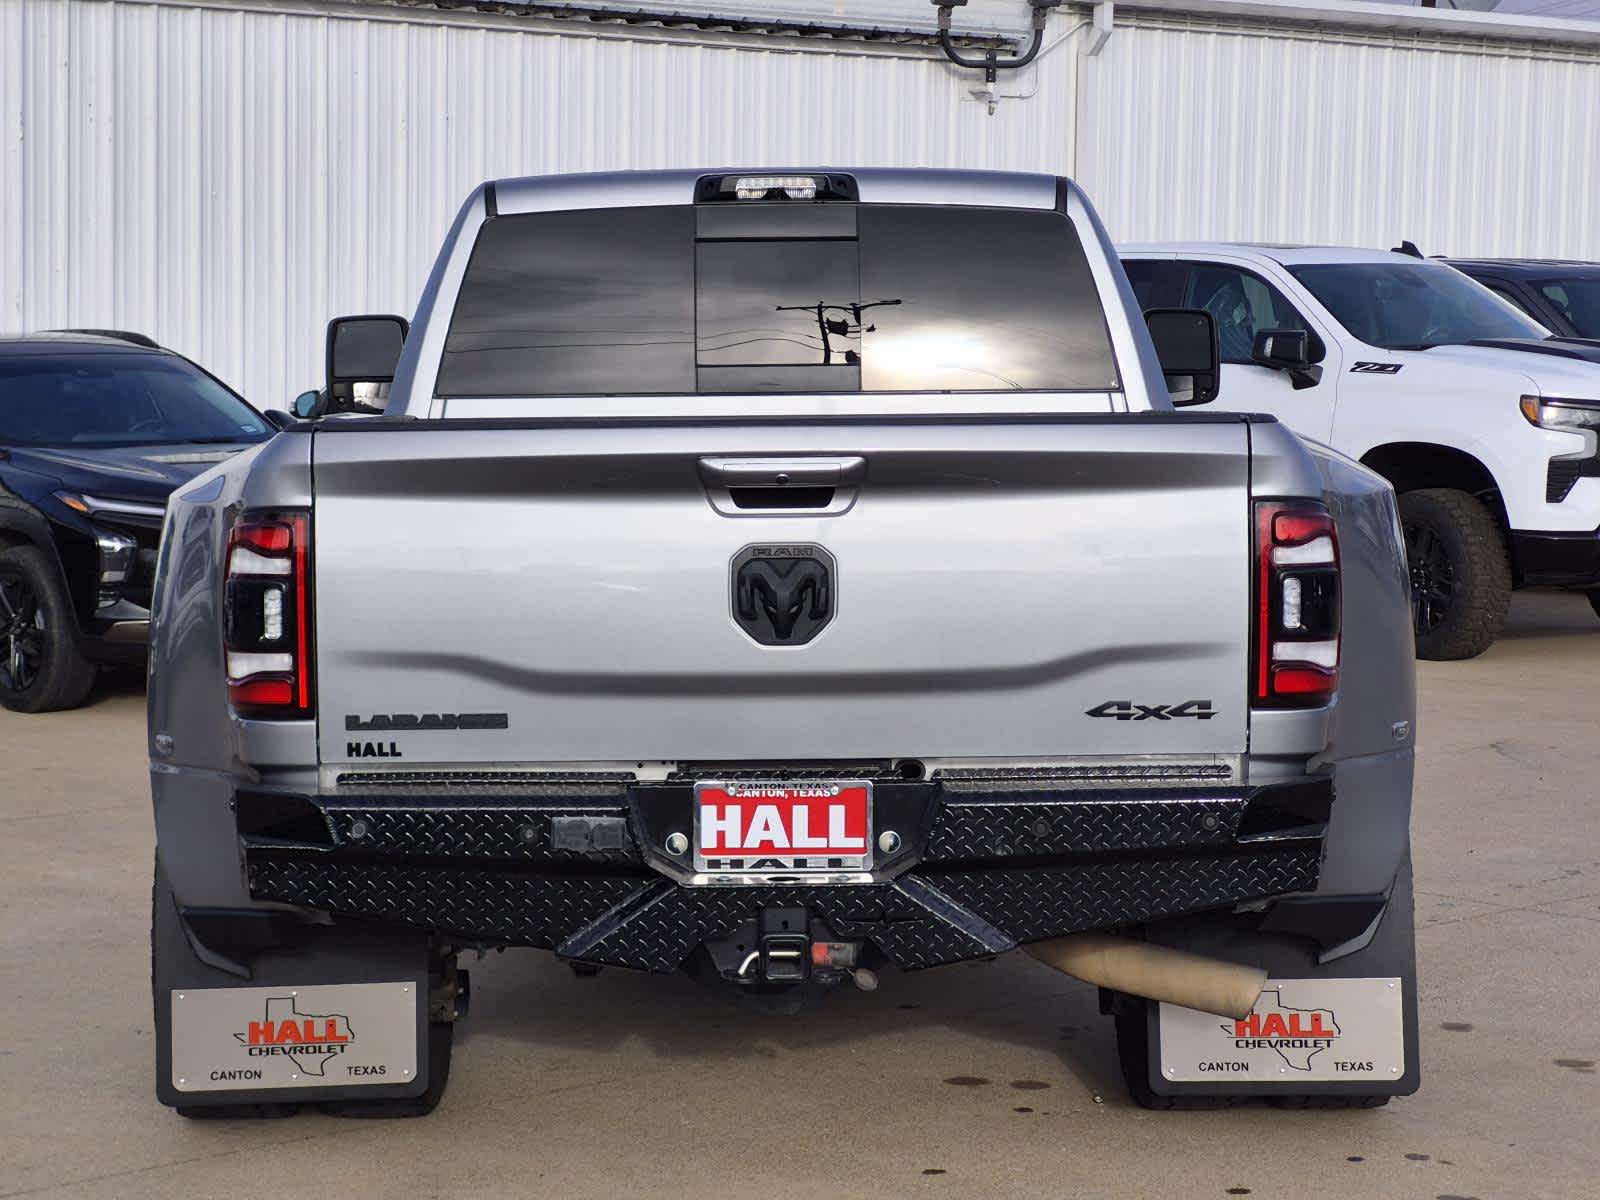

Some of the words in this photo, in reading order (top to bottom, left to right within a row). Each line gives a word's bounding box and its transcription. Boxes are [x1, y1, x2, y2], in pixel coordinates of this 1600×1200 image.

[752, 547, 814, 557] RAM
[1084, 700, 1218, 720] 4x4
[346, 742, 402, 757] HALL
[793, 789, 831, 798] TEXAS
[701, 804, 865, 848] HALL
[707, 858, 861, 869] HALL
[1235, 1013, 1334, 1037] HALL
[249, 1019, 348, 1045] HALL
[249, 1044, 347, 1056] CHEVROLET
[1235, 1039, 1334, 1049] CHEVROLET
[210, 1070, 262, 1081] CANTON
[347, 1065, 386, 1076] TEXAS
[1199, 1062, 1249, 1072] CANTON
[1334, 1061, 1374, 1072] TEXAS
